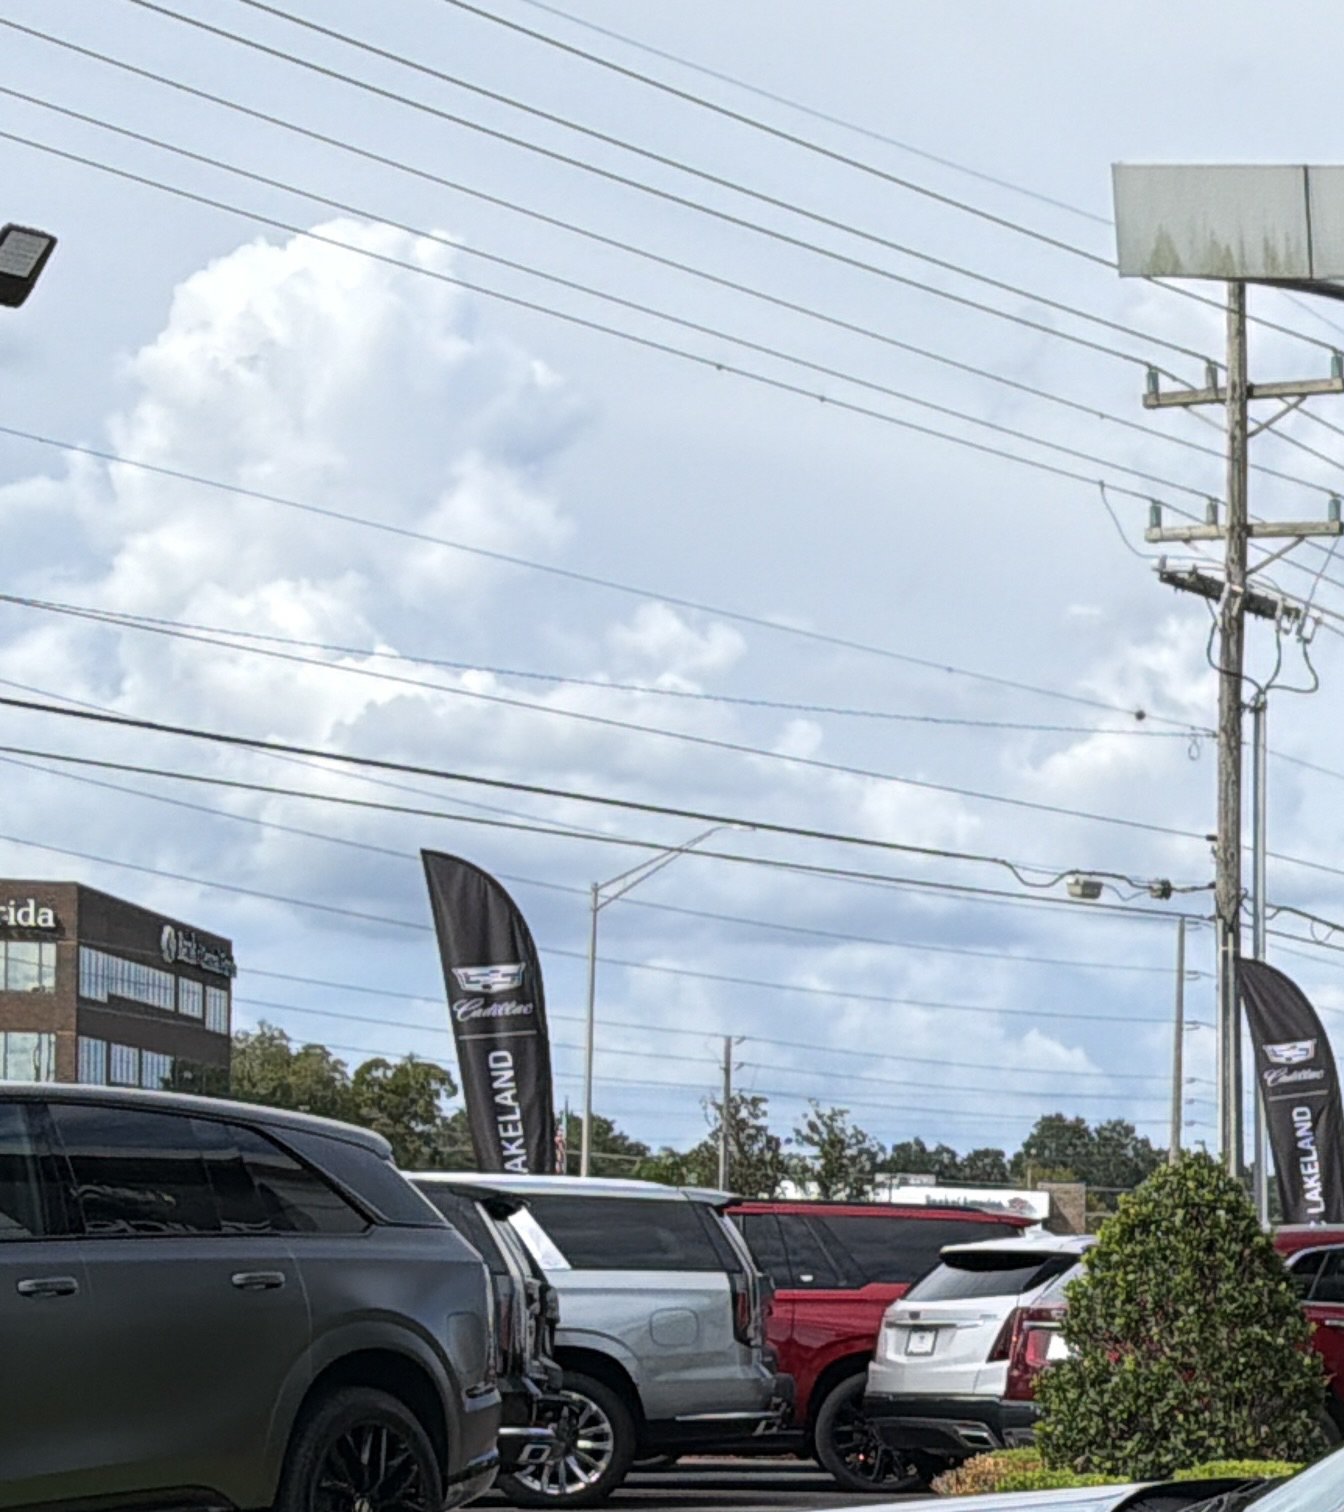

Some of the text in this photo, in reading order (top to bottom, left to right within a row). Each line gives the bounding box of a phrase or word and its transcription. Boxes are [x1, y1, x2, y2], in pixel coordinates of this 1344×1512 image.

[453, 999, 534, 1022] Cadillac
[488, 1050, 529, 1175] AKELAND
[1292, 1106, 1326, 1215] LAKELAND
